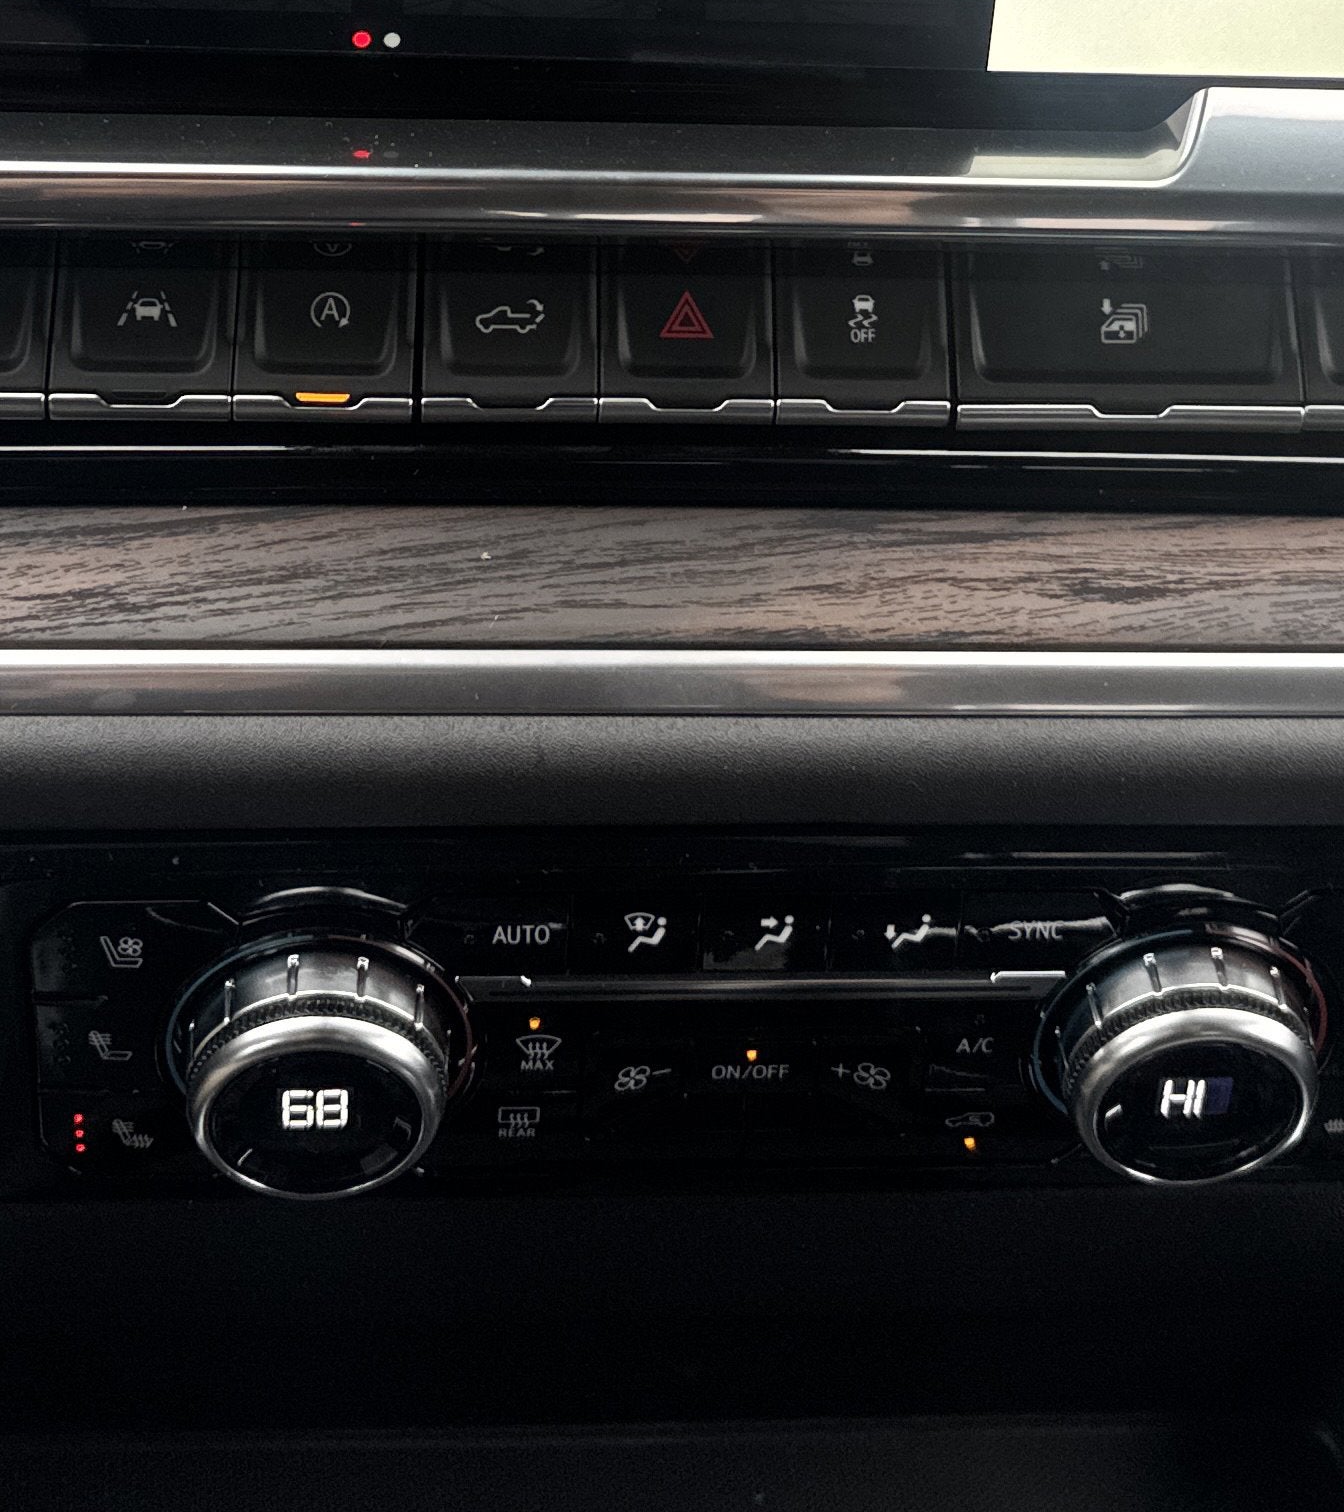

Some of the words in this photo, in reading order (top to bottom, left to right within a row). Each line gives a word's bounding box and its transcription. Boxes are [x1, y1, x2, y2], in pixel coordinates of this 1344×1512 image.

[320, 298, 339, 320] A
[850, 329, 875, 344] OFF
[492, 924, 551, 945] AUTO
[1008, 921, 1063, 941] SYNC
[956, 1038, 994, 1054] A/C
[521, 1060, 554, 1071] MAX
[711, 1063, 789, 1081] ON/OFF
[1161, 1079, 1205, 1118] HI
[282, 1089, 348, 1130] 68
[498, 1127, 536, 1138] REAR
